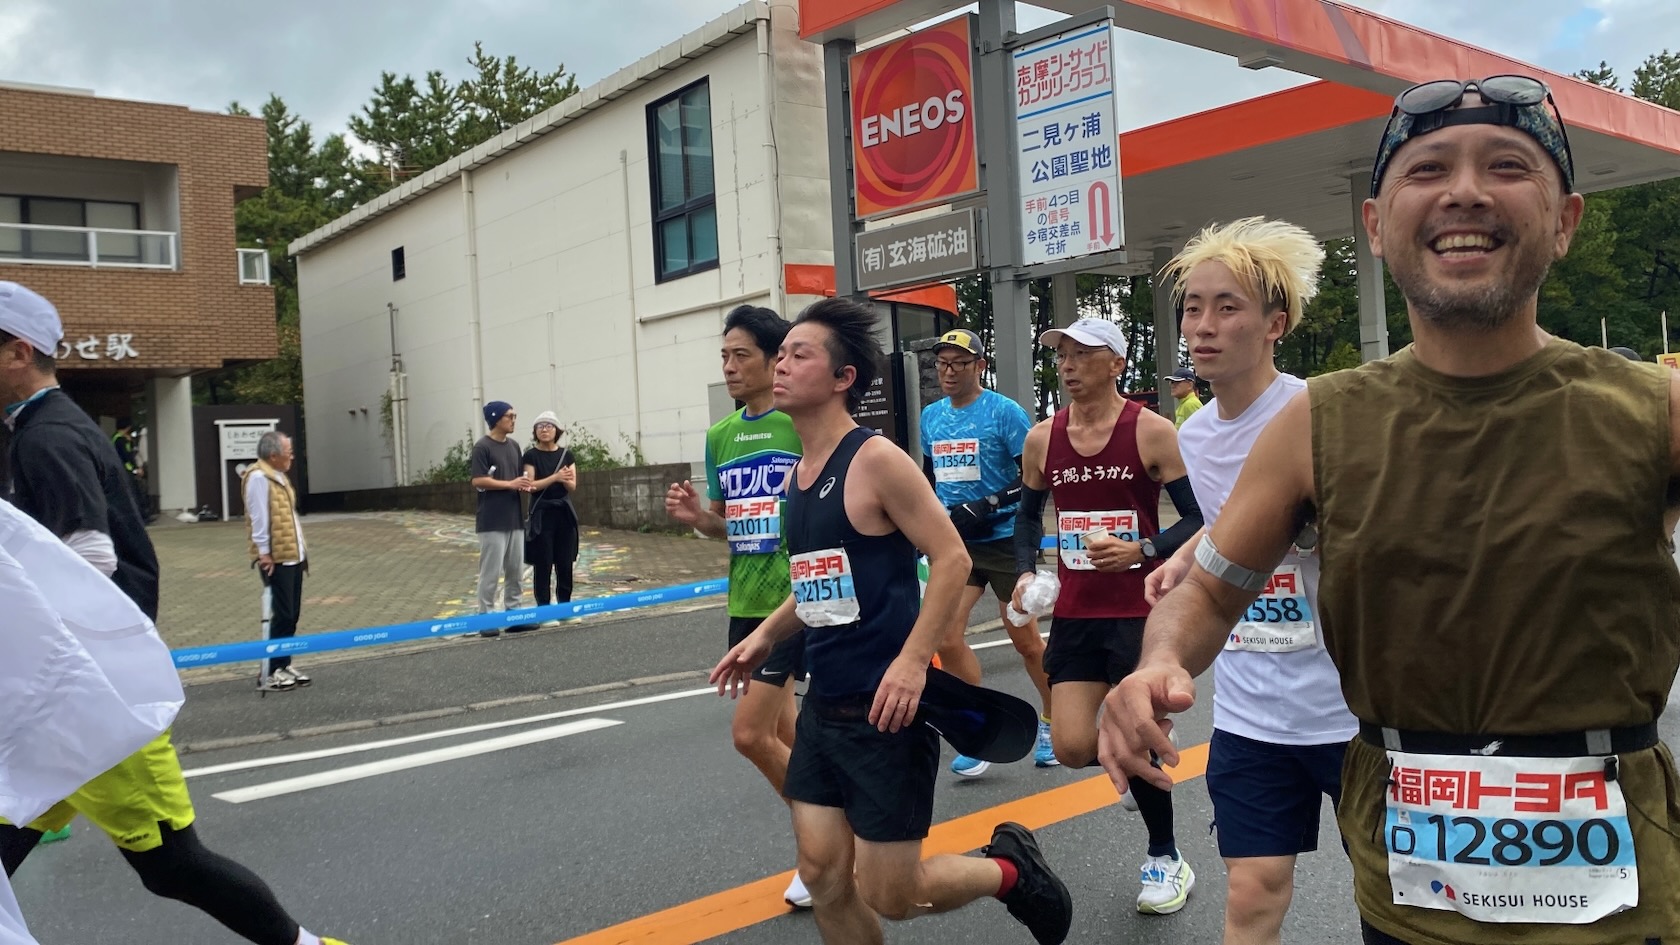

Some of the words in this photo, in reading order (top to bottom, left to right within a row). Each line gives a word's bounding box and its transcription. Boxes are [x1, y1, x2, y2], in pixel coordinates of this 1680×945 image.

[1017, 40, 1108, 87] 志摩シーサイド
[1018, 62, 1111, 107] カンツリークラブ
[861, 89, 965, 148] ENEOS
[1031, 144, 1112, 183] 公園聖地
[1037, 207, 1070, 226] の信号
[1027, 221, 1081, 245] 今宿交差点
[1045, 240, 1067, 256] 右折
[1087, 241, 1100, 251] 手前
[934, 442, 976, 454] 福岡トヨタ
[941, 454, 976, 468] 13542
[1052, 466, 1134, 486] 三隅ようかん
[726, 501, 775, 519] 岡トヨタ
[730, 517, 770, 536] 21011
[1061, 516, 1133, 531] 福岡トヨタ
[1062, 539, 1069, 550] C
[801, 577, 843, 603] 12151
[1242, 637, 1267, 645] SEKISUI
[1269, 637, 1294, 645] HOUSE
[1391, 766, 1608, 812] 福岡トヨタ
[1391, 825, 1416, 855] D
[1428, 814, 1619, 865] 12890
[1620, 867, 1627, 879] 5
[1463, 892, 1524, 907] SEKISUI
[1533, 894, 1589, 908] HOUSE
